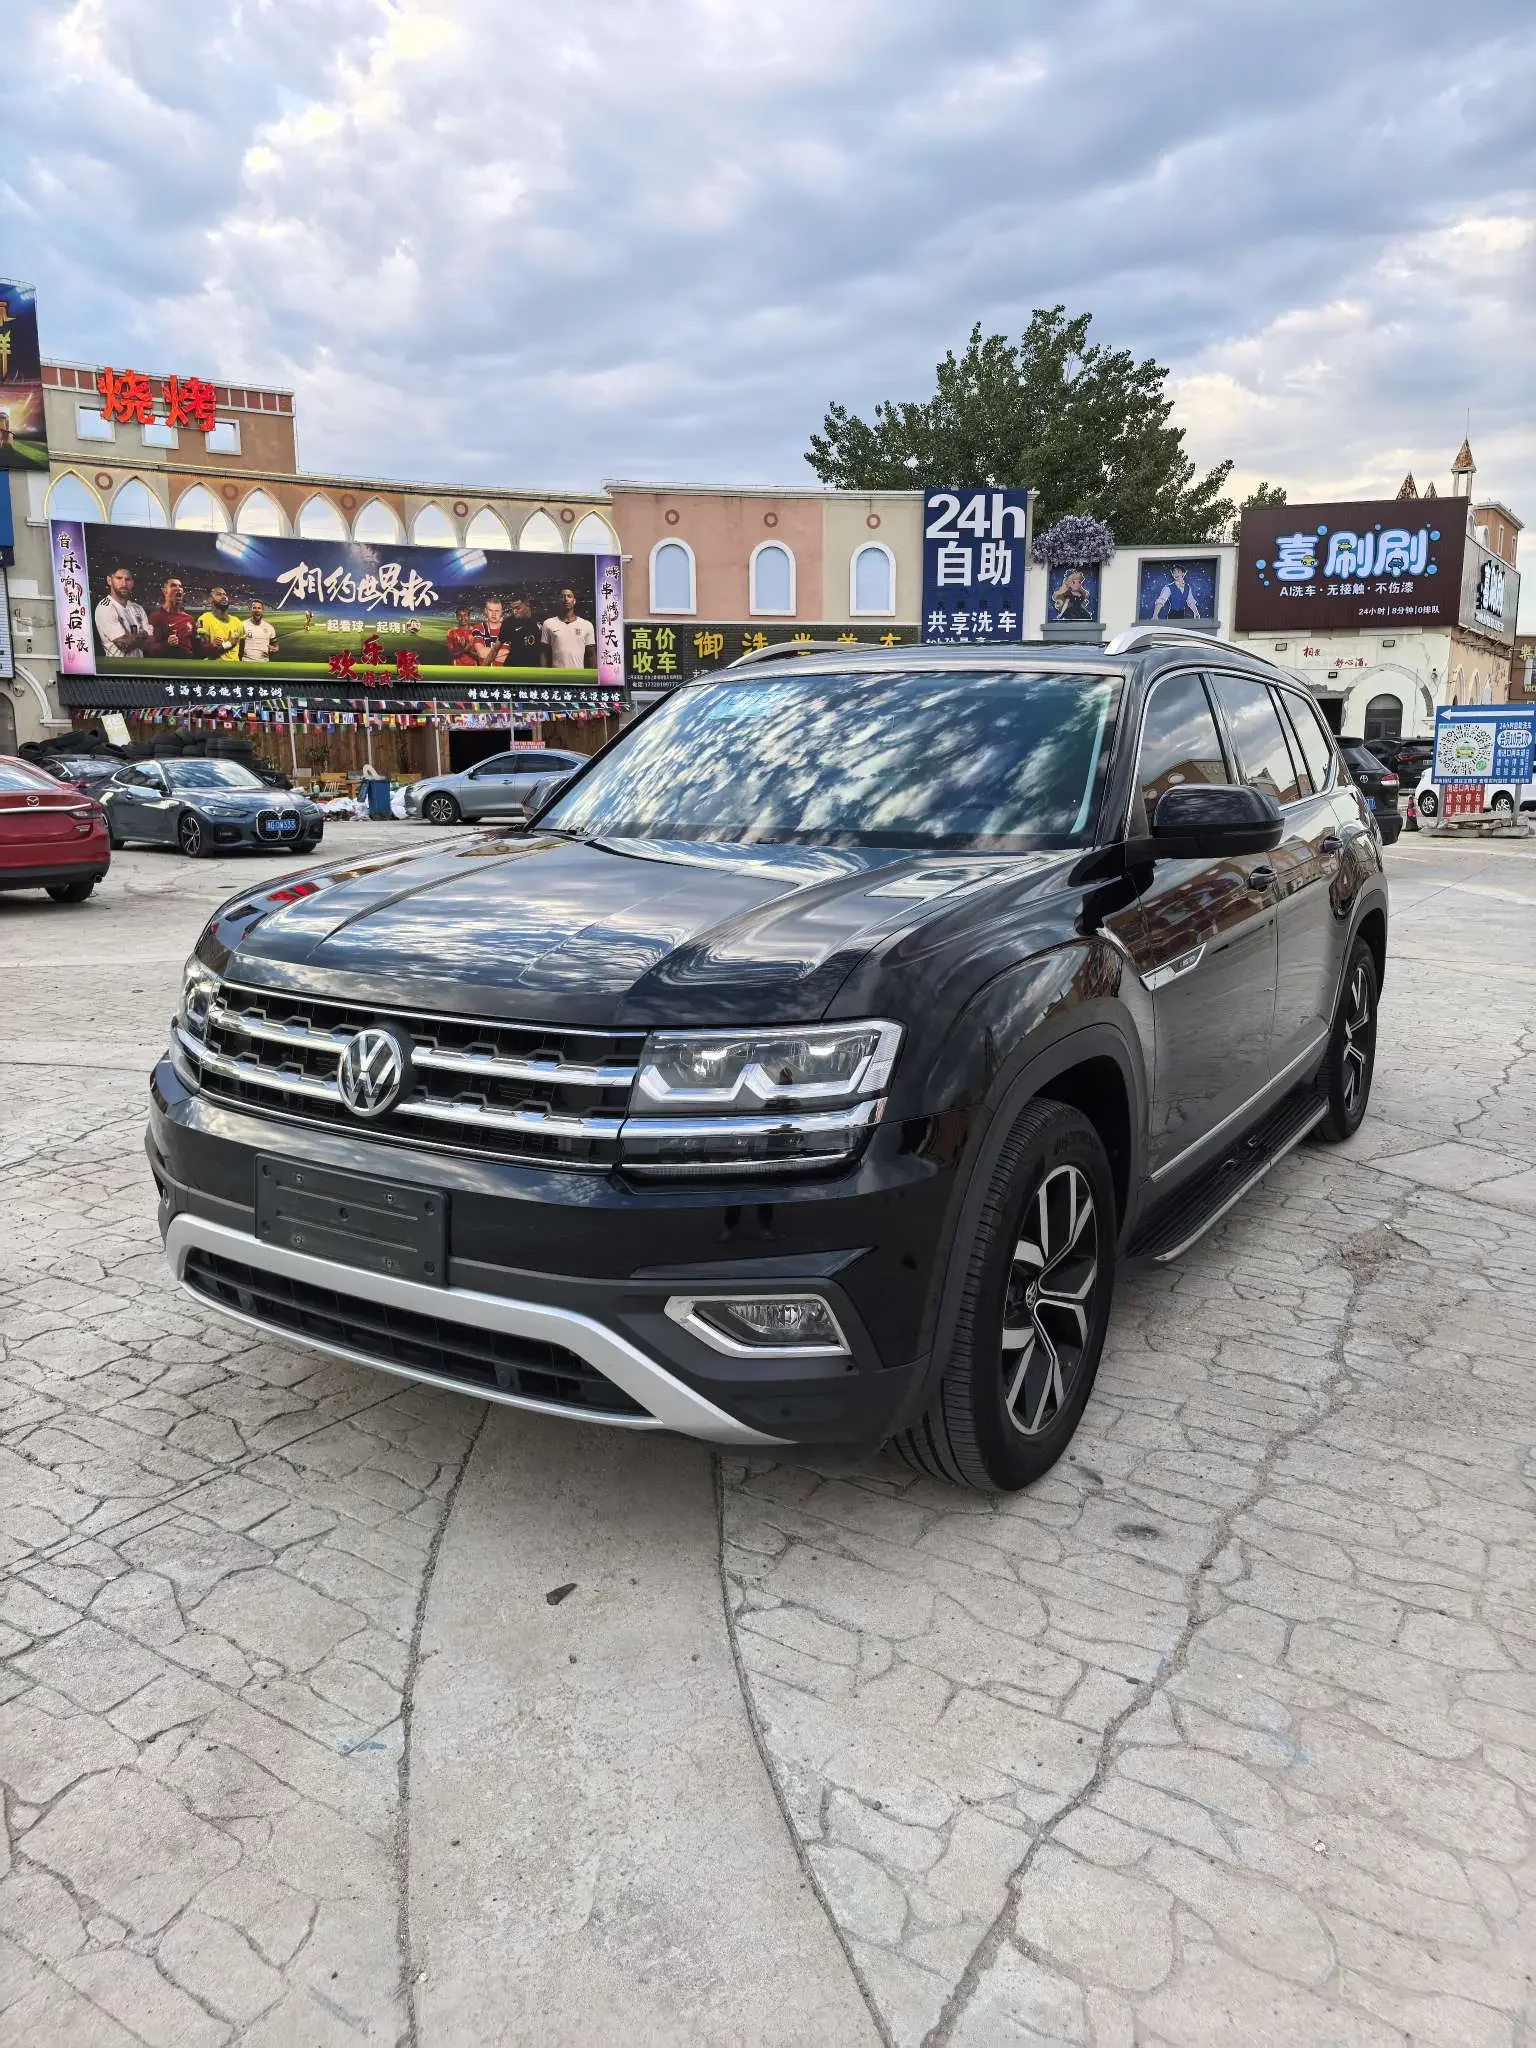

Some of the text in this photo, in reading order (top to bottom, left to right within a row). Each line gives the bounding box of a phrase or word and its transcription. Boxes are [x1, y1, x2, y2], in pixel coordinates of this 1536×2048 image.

[97, 367, 216, 432] 烧烤
[926, 493, 1026, 538] 24h
[937, 540, 1012, 586] 自助
[1272, 527, 1428, 582] 喜刷刷
[276, 561, 439, 611] 相约世界杯
[631, 627, 677, 651] 高价
[928, 610, 1017, 635] 共享洗车
[632, 651, 678, 674] 收车
